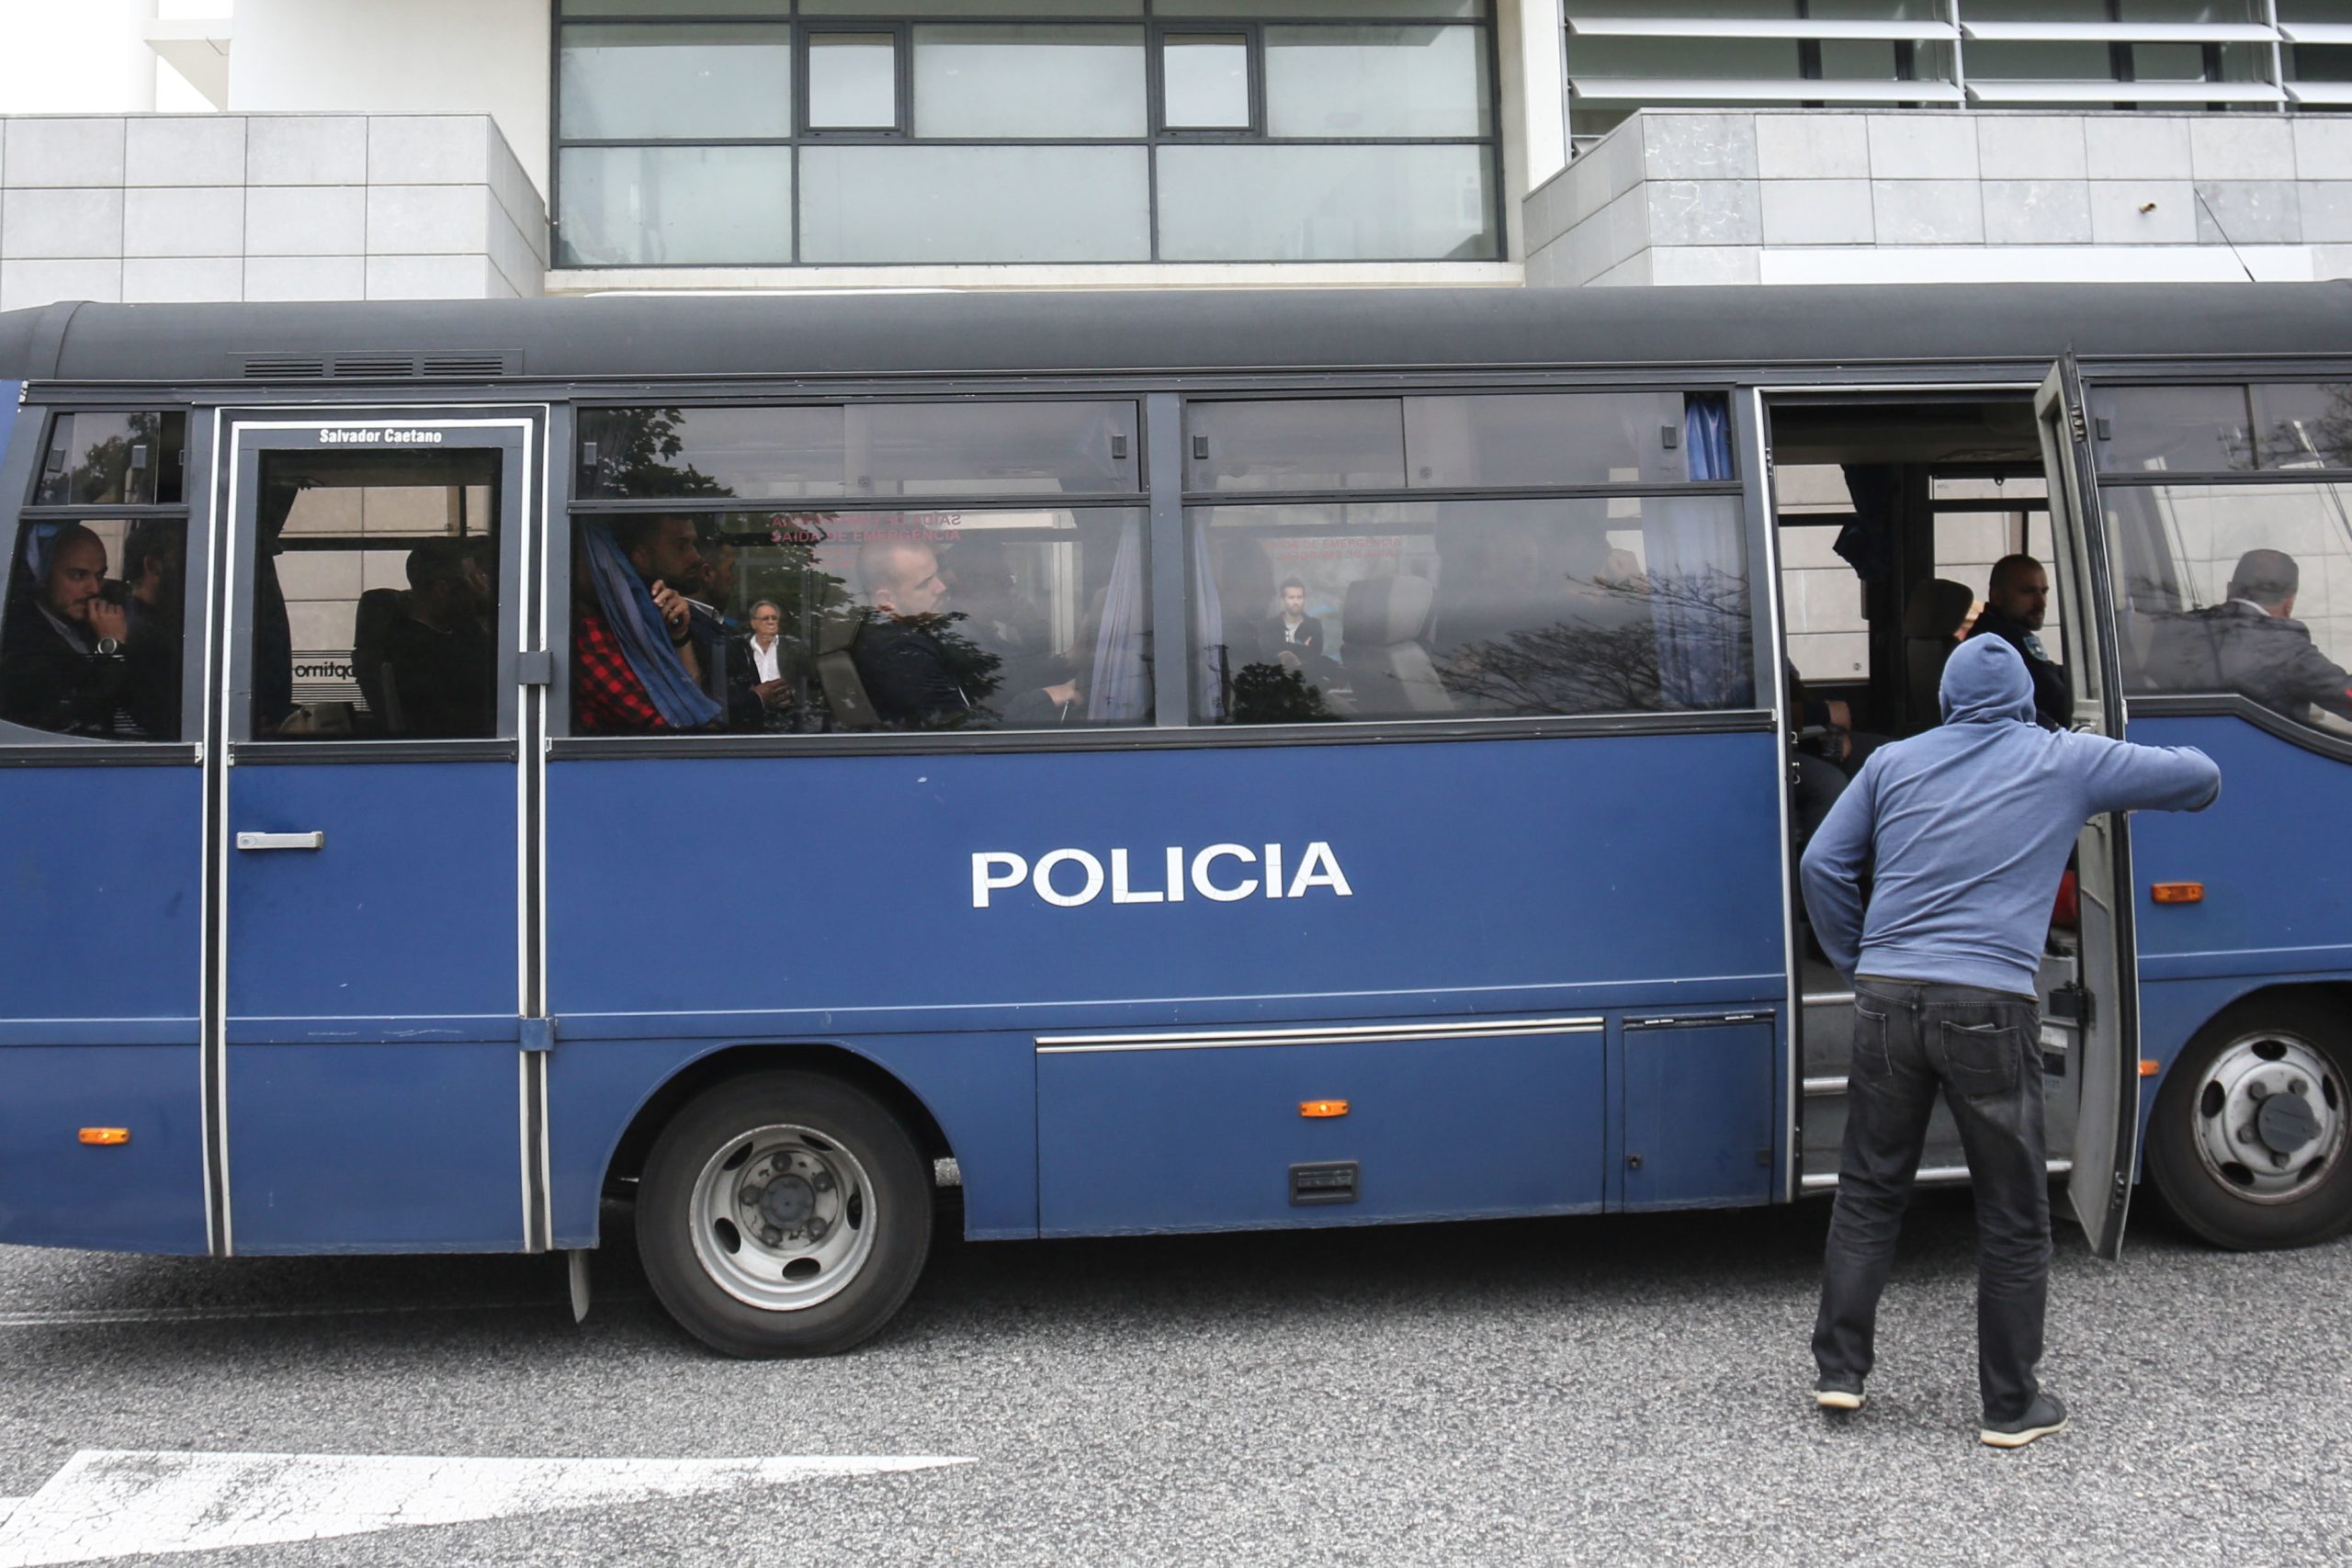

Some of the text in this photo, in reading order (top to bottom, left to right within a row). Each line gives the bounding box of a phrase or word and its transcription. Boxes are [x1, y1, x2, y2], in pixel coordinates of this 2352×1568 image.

[320, 428, 442, 443] Salvador Caetano
[826, 530, 849, 543] DE
[972, 841, 1353, 908] POLICIA
